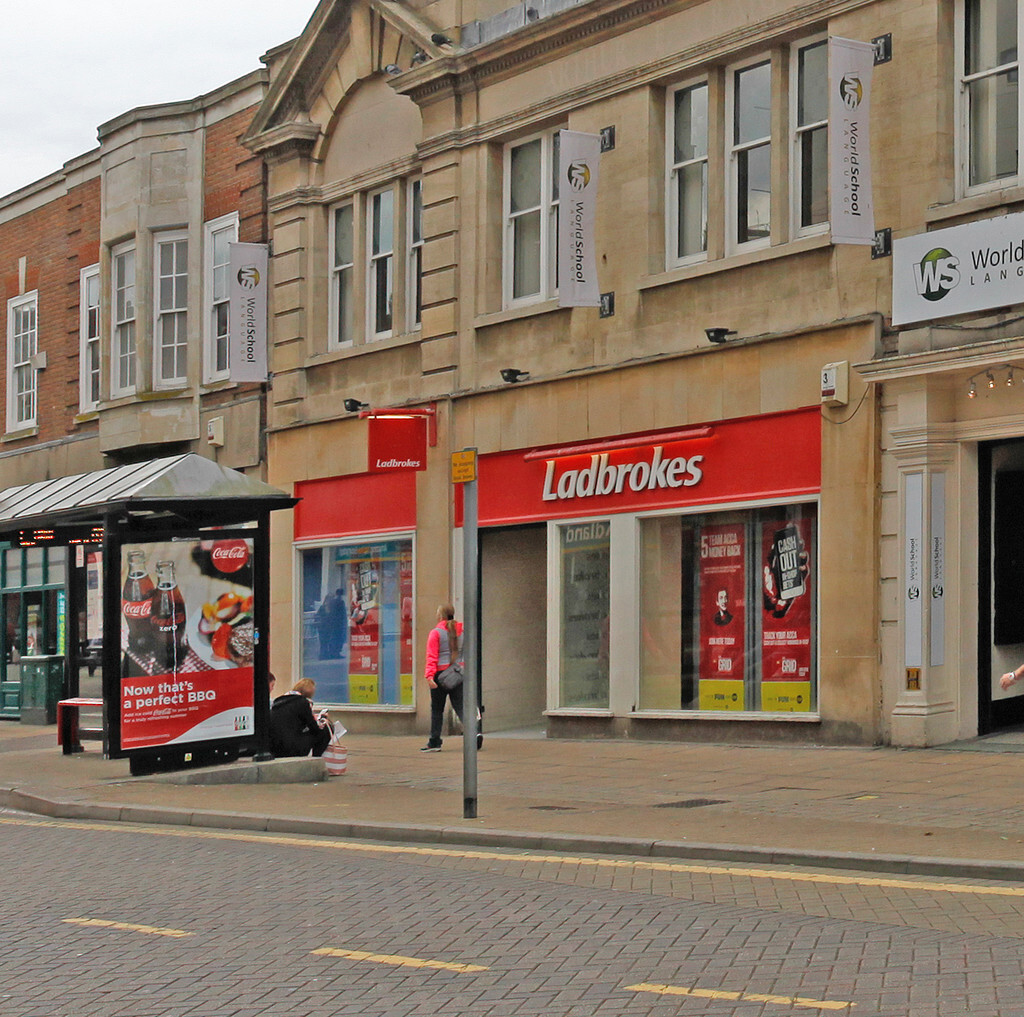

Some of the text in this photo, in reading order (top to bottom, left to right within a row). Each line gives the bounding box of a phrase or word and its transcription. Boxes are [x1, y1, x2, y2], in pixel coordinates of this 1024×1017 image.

[912, 255, 961, 296] WS
[376, 458, 421, 468] Ladbrokes
[541, 445, 704, 502] Ladbrokes
[701, 535, 709, 559] 5
[777, 535, 797, 554] CASH
[779, 549, 797, 572] OUT
[160, 624, 178, 632] zero
[123, 680, 194, 697] Now that's
[123, 690, 216, 710] a perfect BBQ
